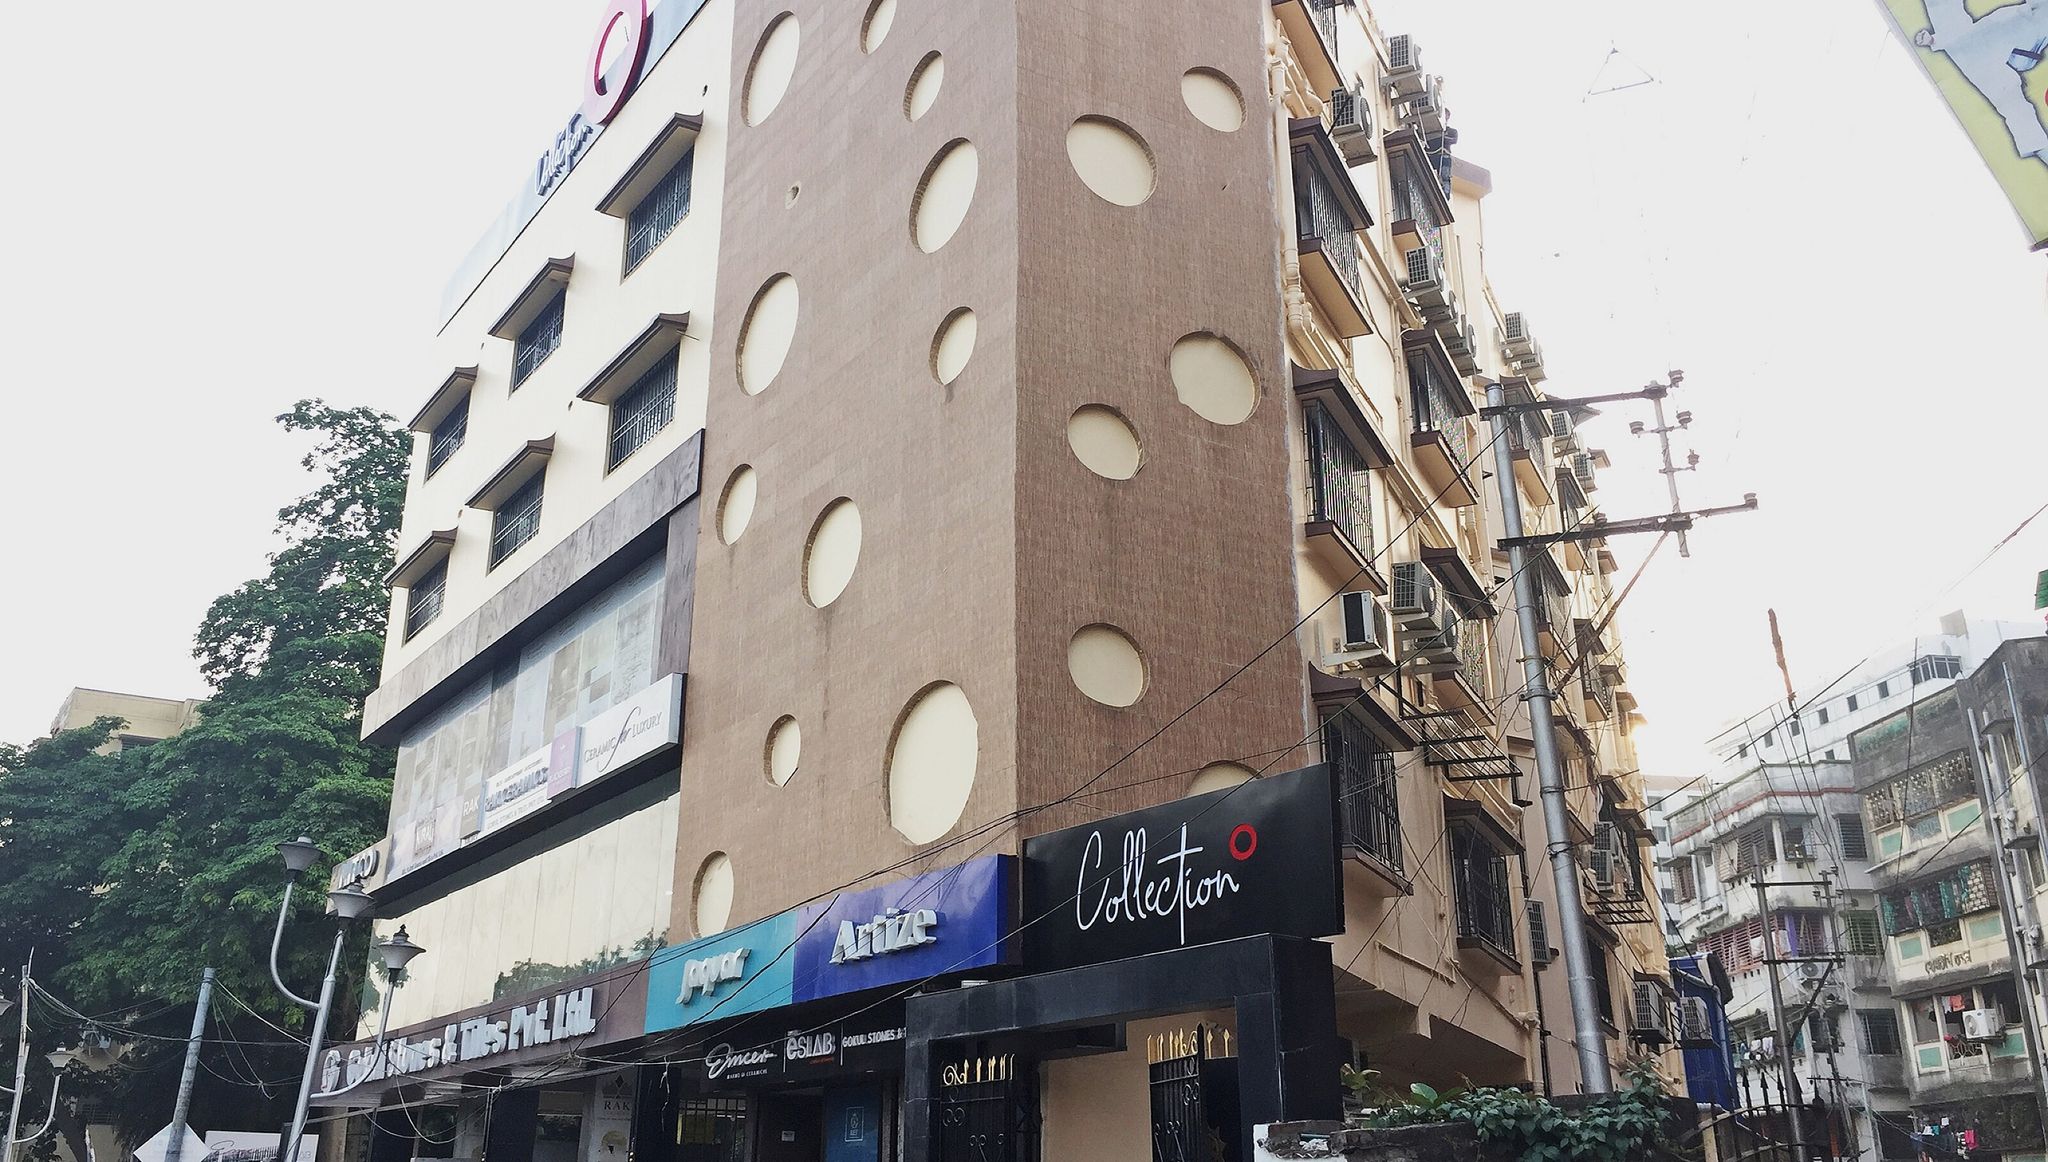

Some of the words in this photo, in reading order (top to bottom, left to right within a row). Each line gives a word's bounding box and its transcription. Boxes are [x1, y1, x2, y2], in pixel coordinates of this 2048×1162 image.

[583, 736, 616, 763] CERAMIC
[632, 712, 662, 738] LUXURY
[463, 795, 480, 816] RAK
[1075, 822, 1240, 945] Collection
[829, 907, 938, 965] Artize
[441, 1024, 458, 1065] &
[460, 1016, 508, 1061] Tiles
[841, 1033, 867, 1048] GOKUL
[867, 1029, 895, 1045] STONES
[604, 1101, 630, 1111] RAK
